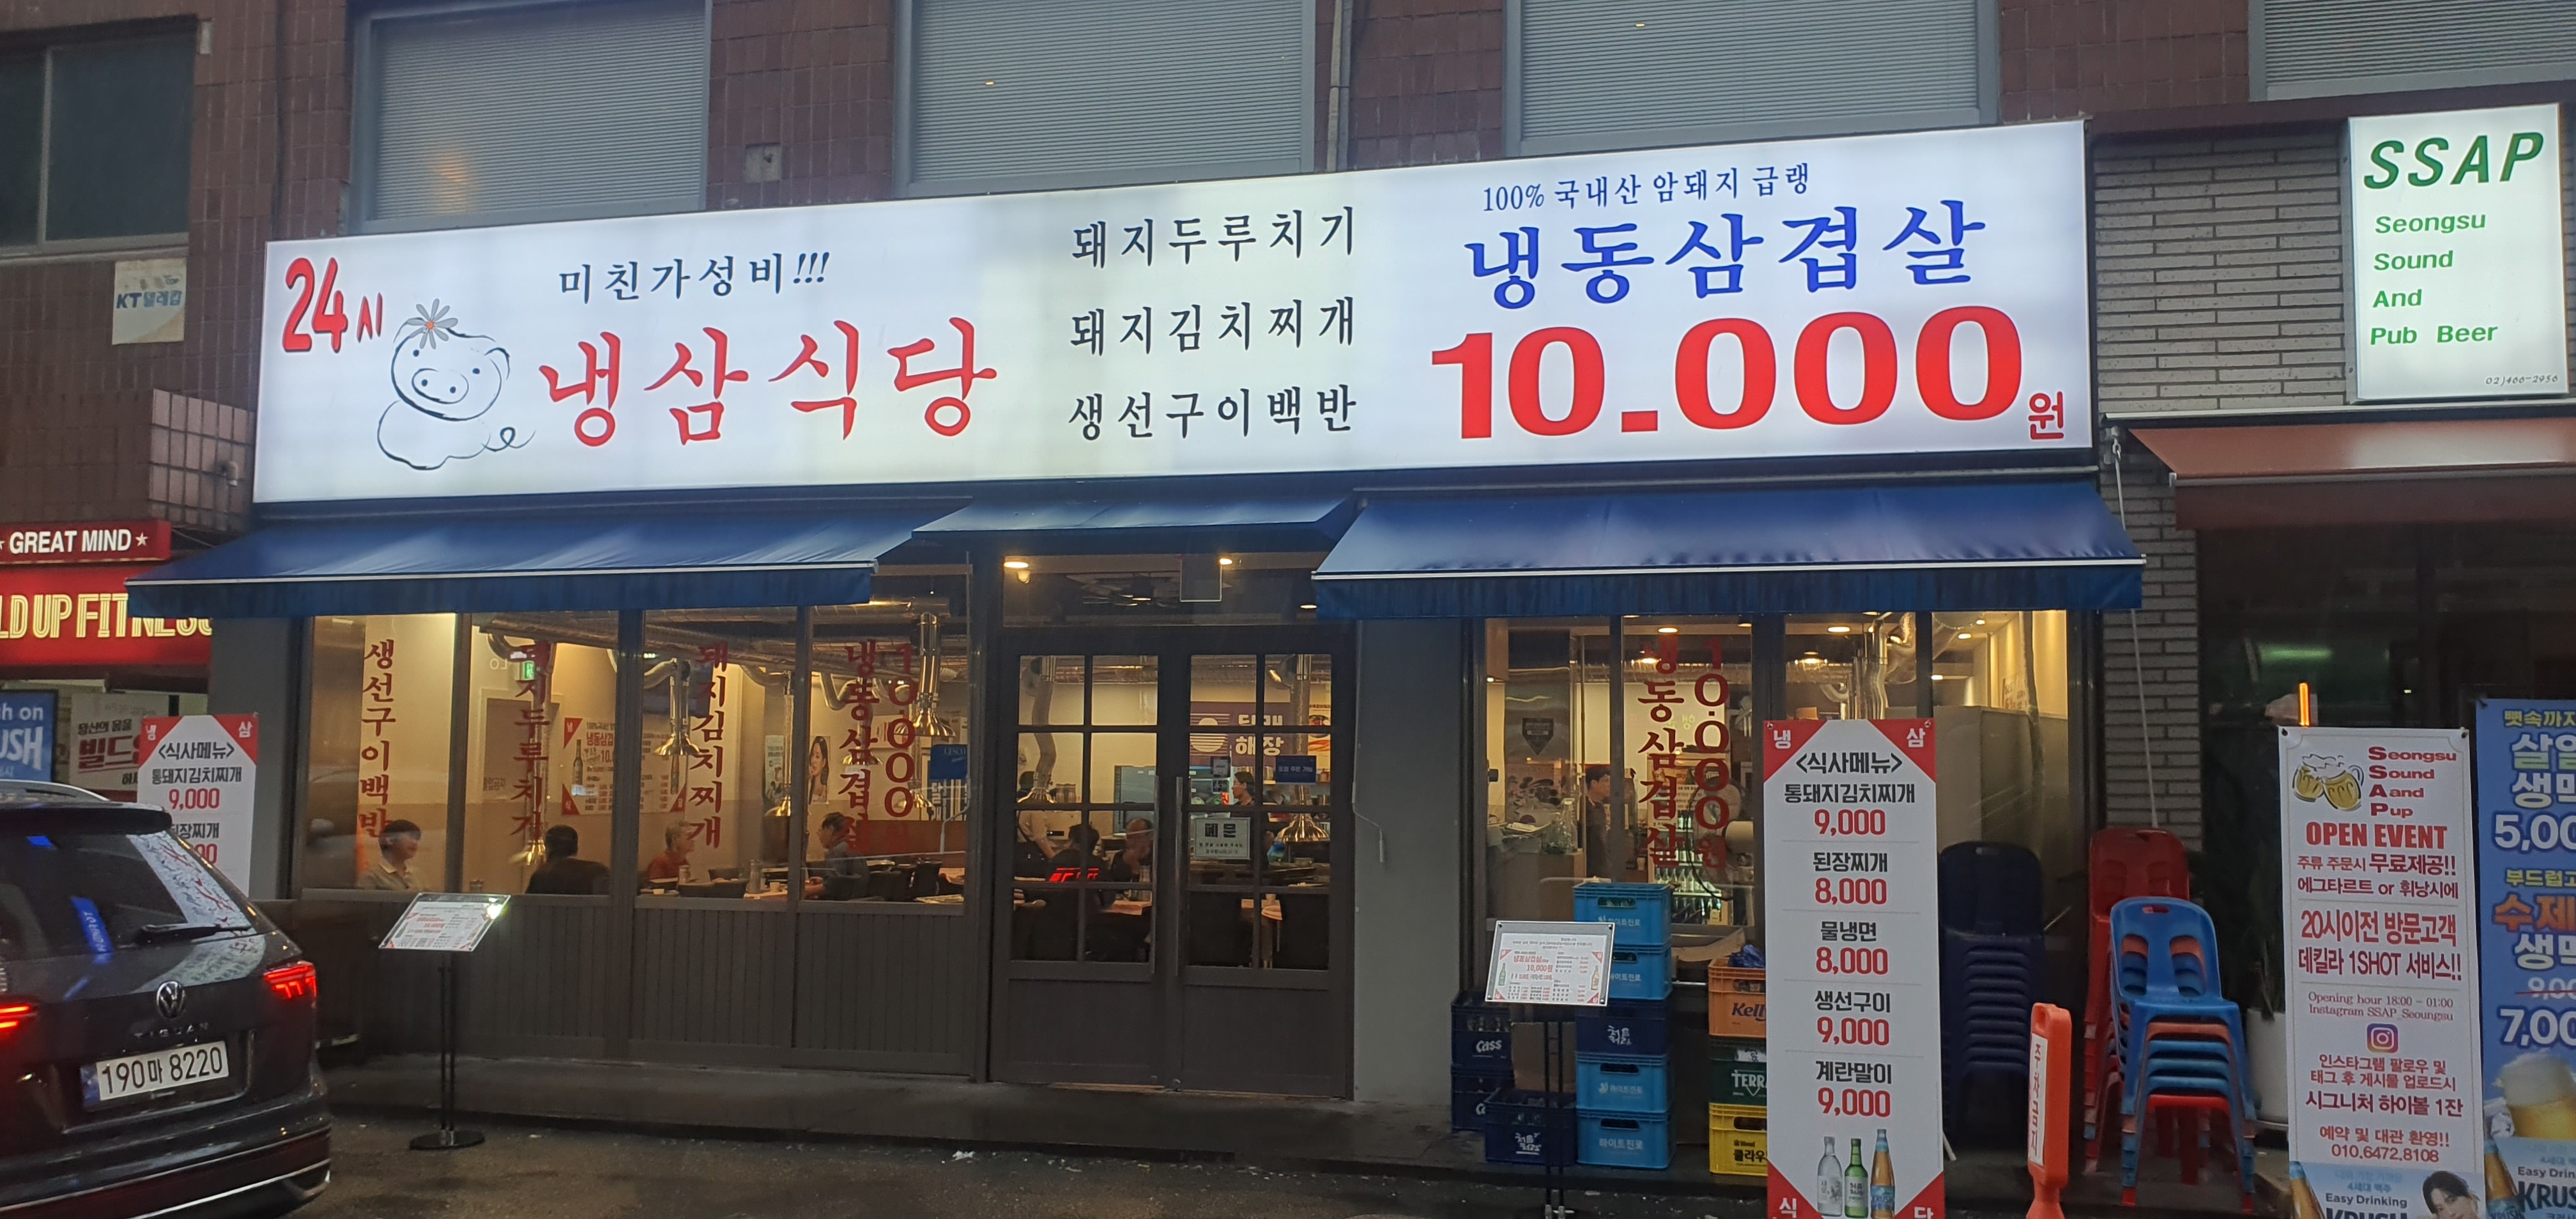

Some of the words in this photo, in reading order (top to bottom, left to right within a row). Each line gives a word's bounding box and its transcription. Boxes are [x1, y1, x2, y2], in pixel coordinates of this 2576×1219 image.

[2364, 132, 2544, 190] SSAP
[1482, 183, 1545, 213] 100%
[1554, 173, 1642, 209] 국내산
[1652, 166, 1740, 204] 암돼지
[1751, 161, 1811, 195] 급랭
[2375, 214, 2486, 234] Seongsu
[1070, 206, 1354, 269] 돼지두루치기
[1464, 199, 1986, 310] 냉동삼겹살
[2373, 250, 2454, 271] Sound
[559, 252, 829, 304] 미친가성비!!!
[281, 256, 383, 354] 24시
[2372, 288, 2423, 308] And
[1069, 296, 1354, 356] 돼지김치찌개
[2370, 326, 2418, 346] Pub
[2437, 325, 2498, 343] Beer
[539, 317, 997, 447] 냉삼식당
[1068, 384, 1357, 442] 생선구이백반
[10, 530, 77, 554] GREAT
[81, 529, 132, 552] MIND
[33, 594, 72, 638] UP
[19, 707, 43, 721] on
[146, 724, 157, 741] 냉
[238, 721, 253, 738] 삼
[358, 639, 397, 839] 생선구이백반
[586, 732, 614, 746] 냉동삼겹
[1774, 730, 1791, 749] 냉
[1906, 728, 1926, 748] 삼
[78, 735, 141, 770] 빌드
[158, 741, 235, 760] <식사메뉴>
[687, 641, 728, 849] 돼지김치찌개
[1637, 635, 1685, 868] 냉동삼겹살
[2368, 746, 2457, 762] Seongsu
[1796, 752, 1903, 774] <식사메뉴>
[2368, 765, 2435, 779] Sound
[151, 766, 242, 785] 통돼지김치찌개
[169, 787, 220, 811] 9,000
[1784, 783, 1915, 804] 통돼지김치찌개
[2371, 802, 2413, 818] Pup
[1814, 809, 1886, 836] 9,000
[2306, 822, 2367, 846] OPEN
[2375, 824, 2448, 849] EVENT
[1813, 852, 1888, 872] 된장찌개
[2297, 856, 2323, 870] 주류
[2327, 857, 2366, 872] 주문시
[2369, 854, 2456, 875] 무료제공!!
[1815, 878, 1888, 905] 8,000
[2298, 877, 2373, 894] 에그타르트
[2379, 883, 2395, 894] or
[2400, 880, 2458, 899] 휘낭시에
[1820, 921, 1877, 942] 물냉면
[2301, 909, 2379, 943] 20시이전
[2384, 912, 2457, 947] 방문고객
[1816, 946, 1889, 975] 8,000
[2299, 947, 2343, 975] 데킬라
[2349, 950, 2402, 976] 1SHOT
[2406, 951, 2462, 981] 서비스!!
[1814, 990, 1890, 1013] 생선구이
[2308, 992, 2353, 1005] Opening
[2357, 994, 2382, 1005] hour
[2386, 995, 2412, 1006] 18:00
[2426, 998, 2453, 1008] 01:00
[2309, 1004, 2364, 1017] Instagram
[1817, 1016, 1890, 1046] 9,000
[1476, 1039, 1502, 1053] Cass
[102, 1058, 163, 1094] 190마
[169, 1046, 223, 1082] 8220
[1815, 1060, 1892, 1084] 계란말이
[2319, 1054, 2385, 1072] 인스타그램
[2389, 1058, 2428, 1073] 팔로우
[2434, 1060, 2446, 1075] 및
[1731, 1070, 1767, 1087] TERR
[2311, 1070, 2337, 1085] 태그
[2342, 1071, 2356, 1086] 후
[2404, 1075, 2456, 1091] 업로드시
[1818, 1087, 1891, 1117] 9,000
[2305, 1091, 2373, 1112] 시그니처
[2379, 1094, 2430, 1116] 하이볼
[2435, 1098, 2464, 1117] 1잔
[1599, 1138, 1644, 1150] 하이트진로
[2320, 1126, 2350, 1142] 예약
[2355, 1127, 2368, 1142] 및
[2375, 1128, 2404, 1144] 대관
[2409, 1131, 2450, 1147] 환영!!
[2331, 1144, 2439, 1162] 010.6472.8108
[2518, 1167, 2547, 1178] Easy
[2549, 1169, 2576, 1179] Drin
[2326, 1193, 2354, 1205] Easy
[2356, 1195, 2407, 1209] Drinking
